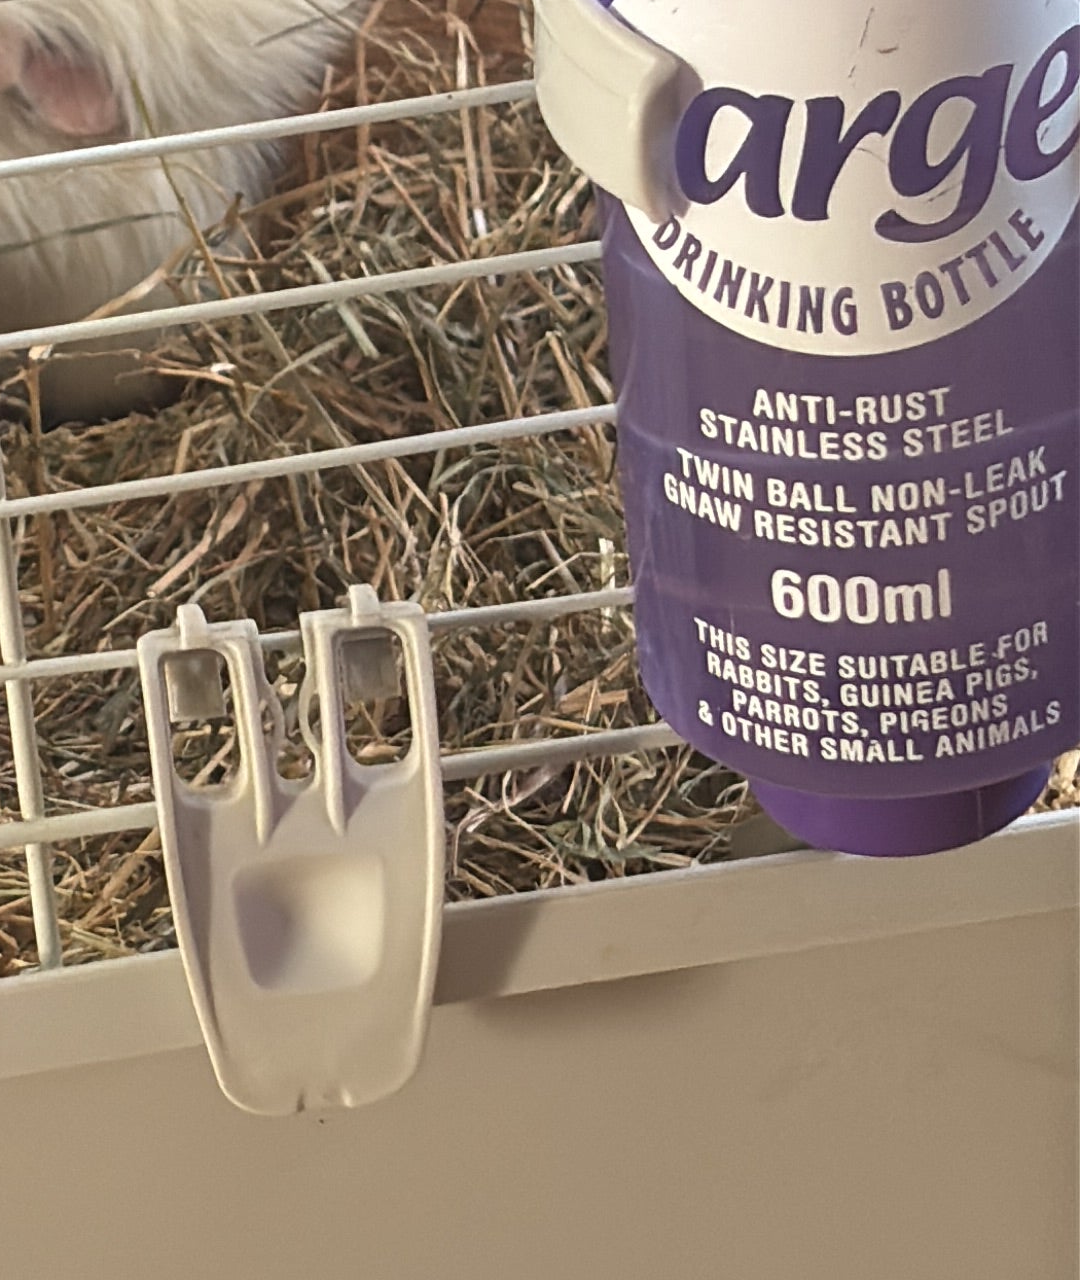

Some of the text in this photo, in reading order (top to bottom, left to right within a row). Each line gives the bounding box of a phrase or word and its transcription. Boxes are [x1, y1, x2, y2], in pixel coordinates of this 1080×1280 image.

[675, 25, 1080, 243] arge
[651, 208, 1045, 336] DRINKING BOTTLE
[699, 409, 1014, 461] STAINLESS STEEL
[753, 387, 951, 425] ANTI-RUST
[663, 470, 1067, 549] GNAW RESISTANT SPOUT
[676, 446, 1047, 513] TWIN BALL NON-LEAK
[771, 568, 952, 624] 600ml
[694, 617, 1048, 679] THIS SIZE SUITABLE FOR
[707, 651, 1039, 710] RABBITS, GUINEA PIGS,
[698, 701, 1061, 763] & OTHER SMALL ANIMALS
[732, 689, 1008, 737] PARROTS, PIGEONS
